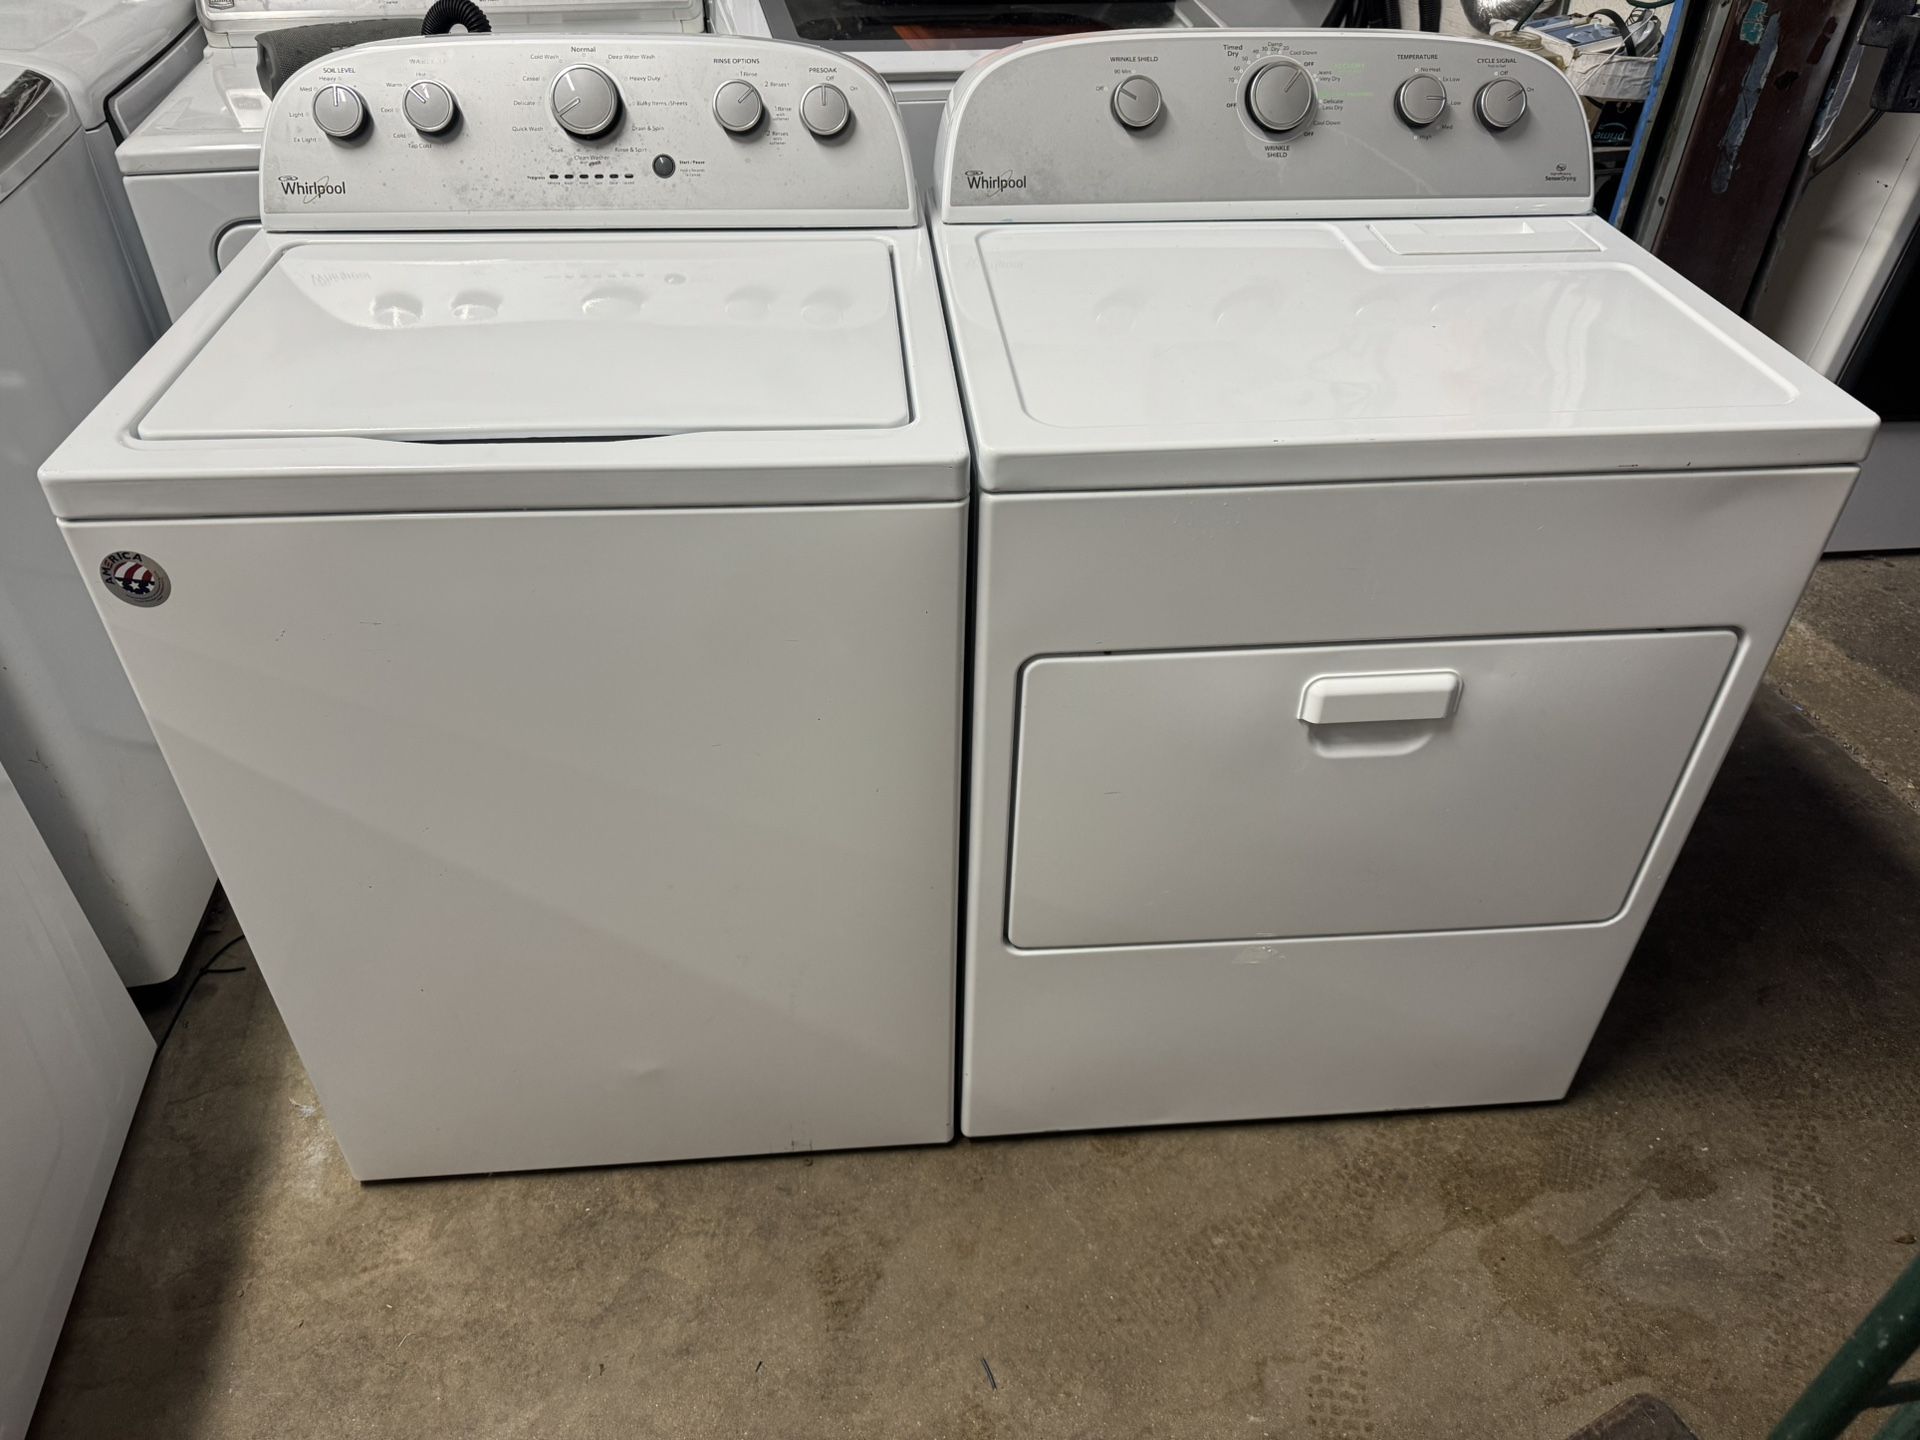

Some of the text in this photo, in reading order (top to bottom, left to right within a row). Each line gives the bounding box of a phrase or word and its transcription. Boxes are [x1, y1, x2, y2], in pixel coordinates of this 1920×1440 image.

[281, 181, 345, 198] Whirlpool
[967, 176, 1026, 192] Whirlpool
[101, 552, 142, 584] AMERICA
